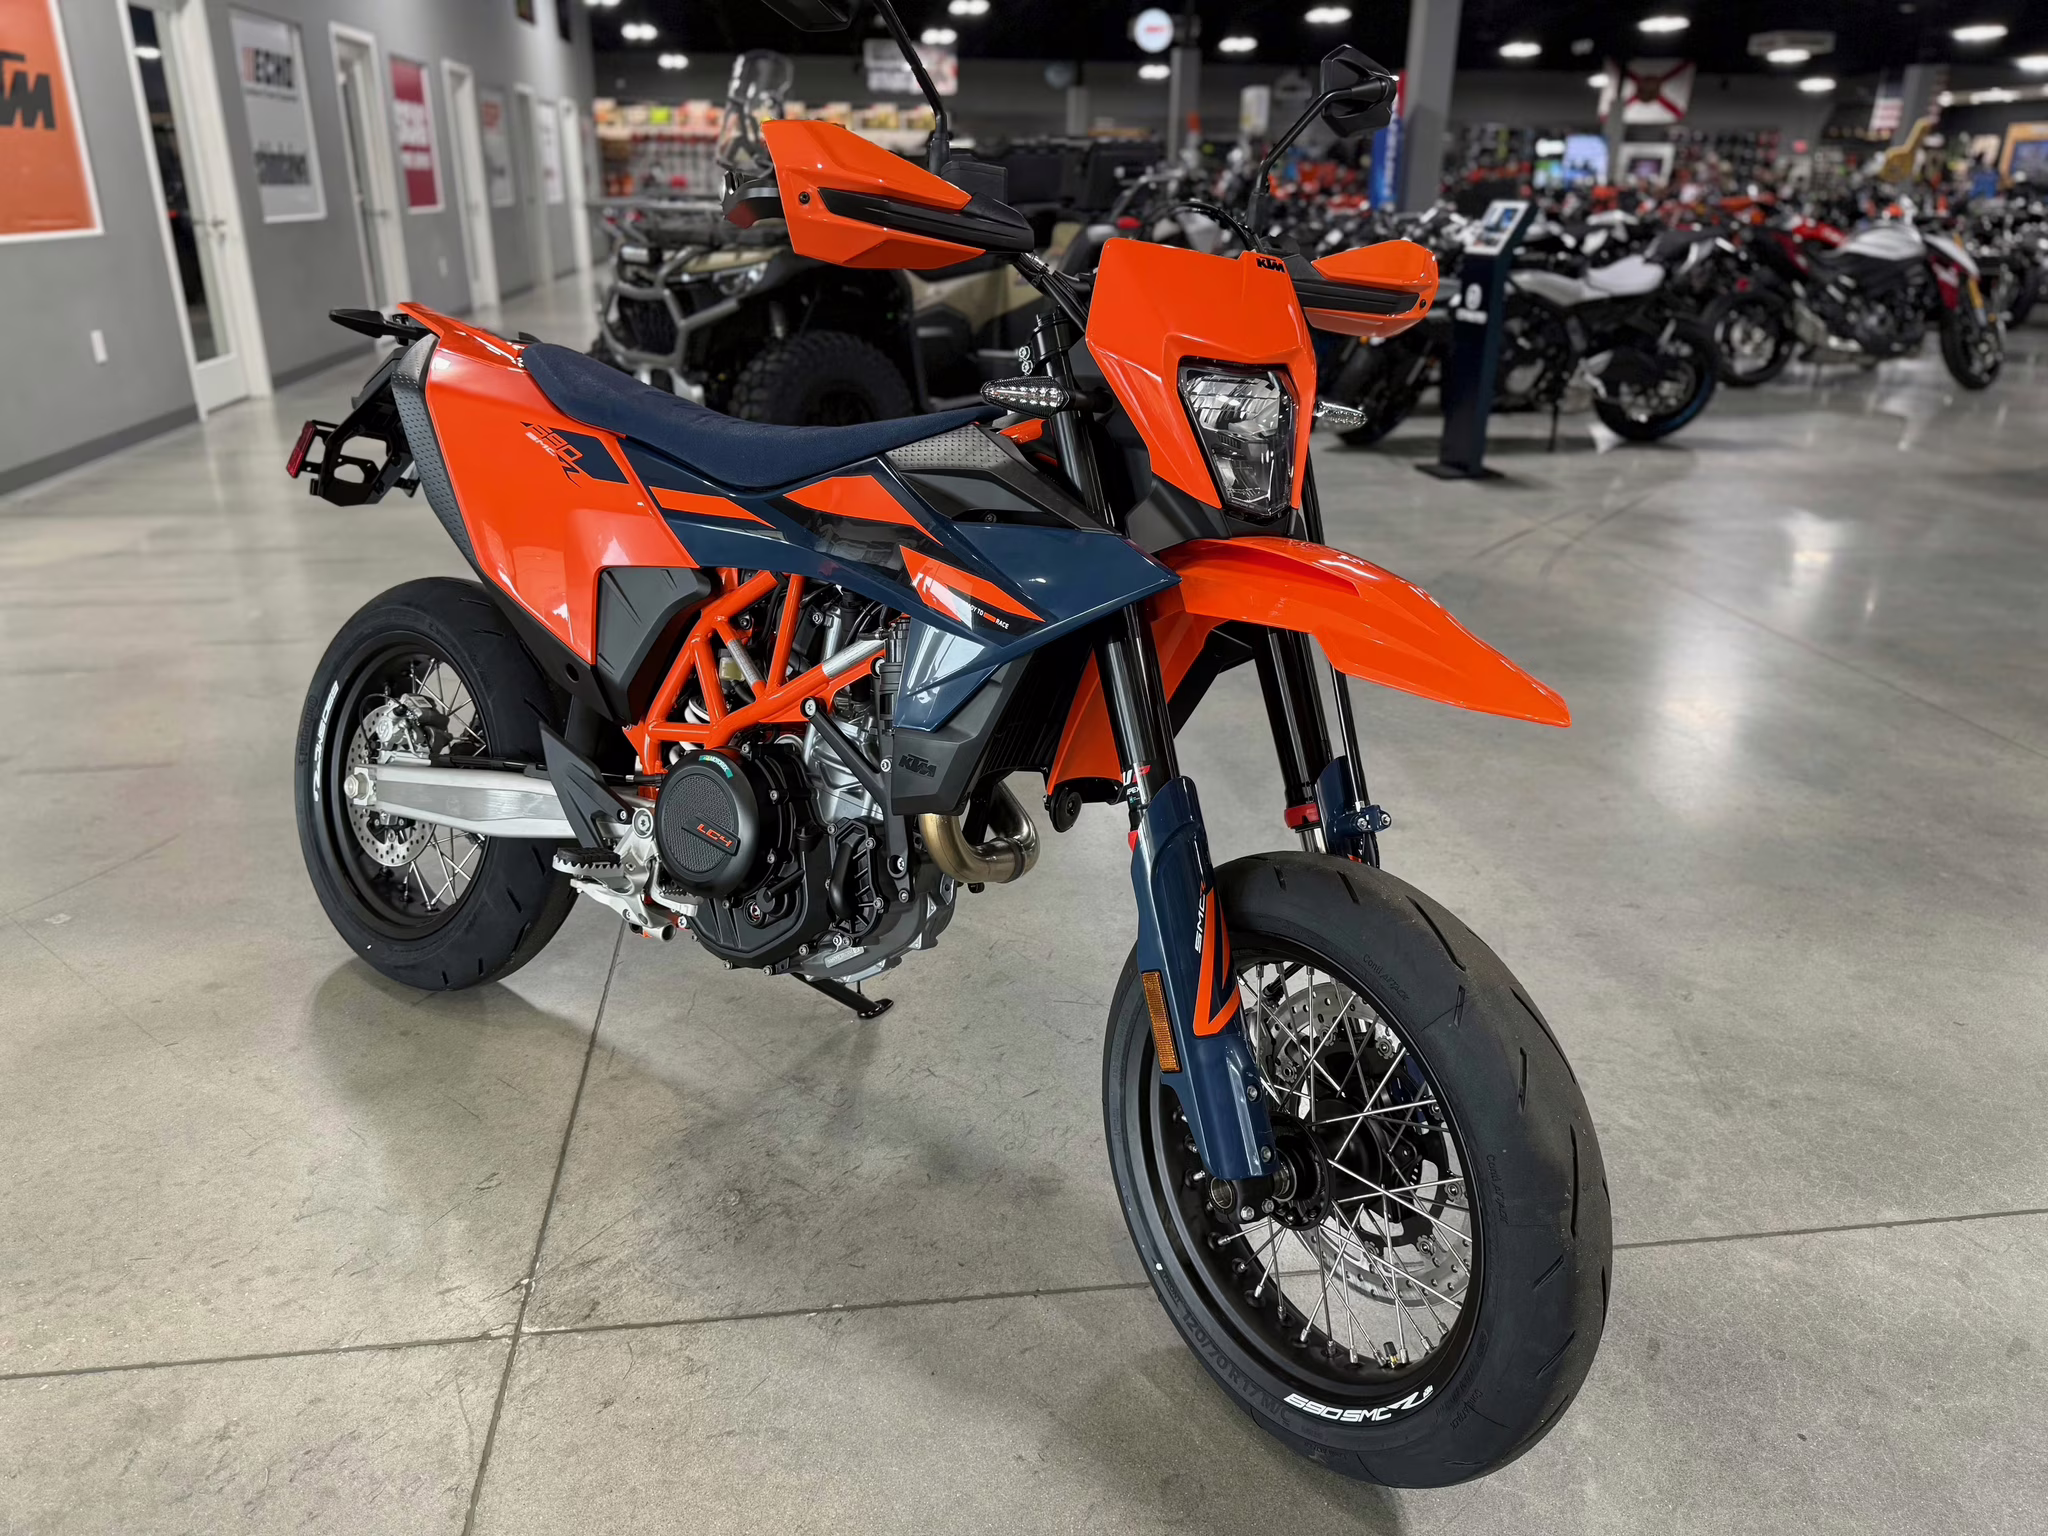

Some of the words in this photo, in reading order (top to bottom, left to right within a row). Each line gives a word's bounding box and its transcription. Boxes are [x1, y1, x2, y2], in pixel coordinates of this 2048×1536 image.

[1256, 256, 1286, 273] KTM
[899, 753, 937, 778] KTM
[696, 823, 733, 848] LC4
[1194, 893, 1206, 954] SMC
